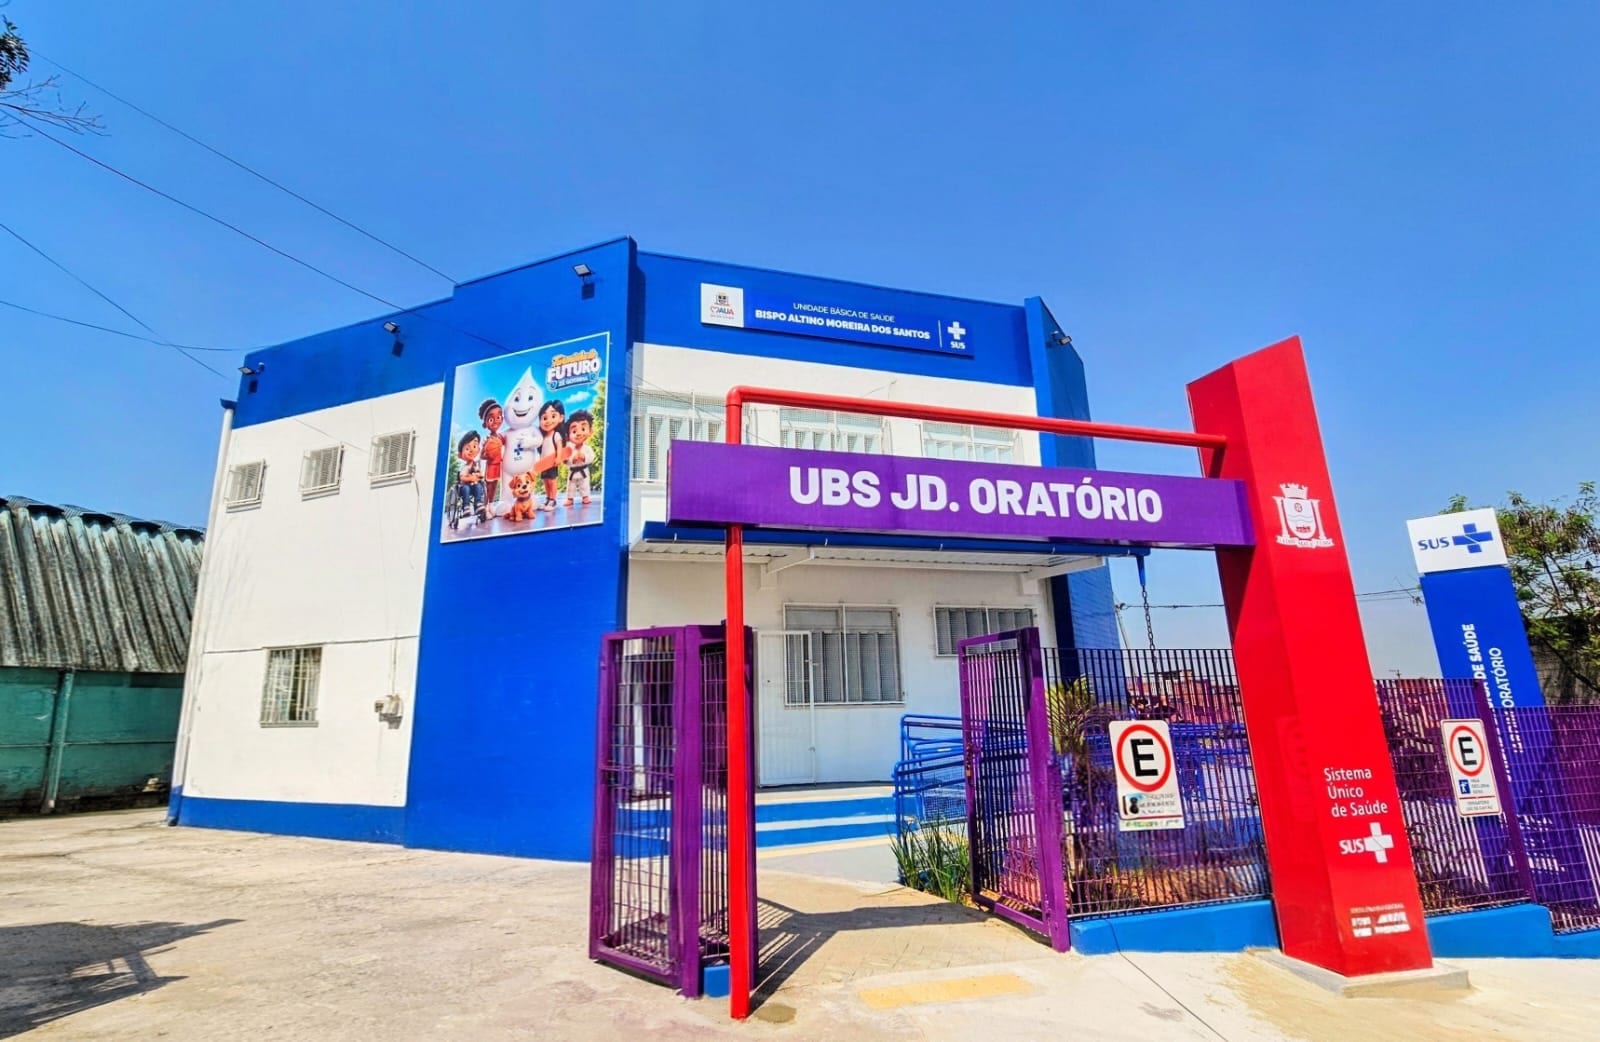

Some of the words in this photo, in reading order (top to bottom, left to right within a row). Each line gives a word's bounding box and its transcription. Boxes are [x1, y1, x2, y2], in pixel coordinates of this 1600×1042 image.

[793, 302, 828, 314] UNIDADE
[830, 306, 858, 318] BÁSICA
[859, 311, 869, 319] DE
[870, 312, 895, 323] SAÚDE
[755, 309, 787, 321] BISPO
[788, 313, 824, 326] ALTINO
[826, 317, 871, 333] MOREIRA
[872, 325, 892, 335] DOS
[893, 328, 931, 340] SANTOS
[950, 341, 966, 350] SUS
[547, 358, 601, 385] FUTURO
[789, 466, 881, 508] UBS
[891, 474, 960, 512] JD.
[969, 477, 1163, 523] ORATÓRIO
[1417, 536, 1450, 551] SUS
[1462, 623, 1483, 662] SAÚDE
[1471, 664, 1487, 680] DE
[1488, 647, 1515, 708] ORATÓRIO
[1130, 738, 1159, 777] E
[1457, 736, 1477, 766] E
[1323, 767, 1372, 782] Sistema
[1327, 782, 1364, 800] Único
[1331, 802, 1348, 818] de
[1350, 800, 1389, 816] Saúde
[1338, 838, 1365, 855] SUS
